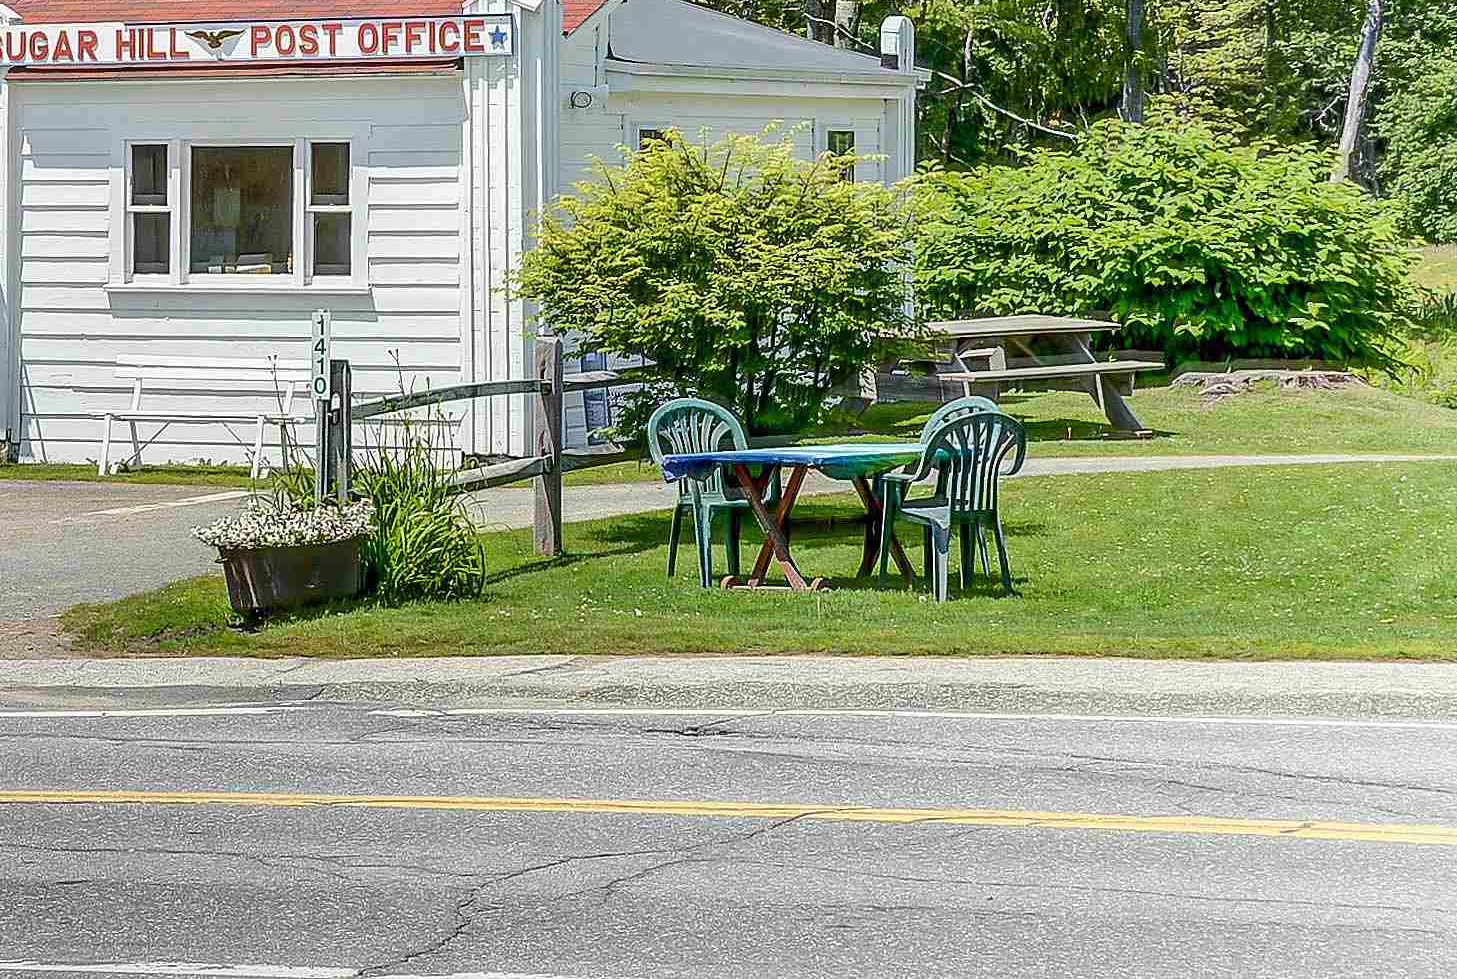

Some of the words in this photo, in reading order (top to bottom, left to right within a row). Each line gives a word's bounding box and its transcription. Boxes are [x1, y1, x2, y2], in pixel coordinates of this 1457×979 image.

[115, 27, 190, 61] HILL
[250, 23, 342, 57] POST
[358, 20, 485, 54] OFFICE
[314, 314, 327, 395] 1410
